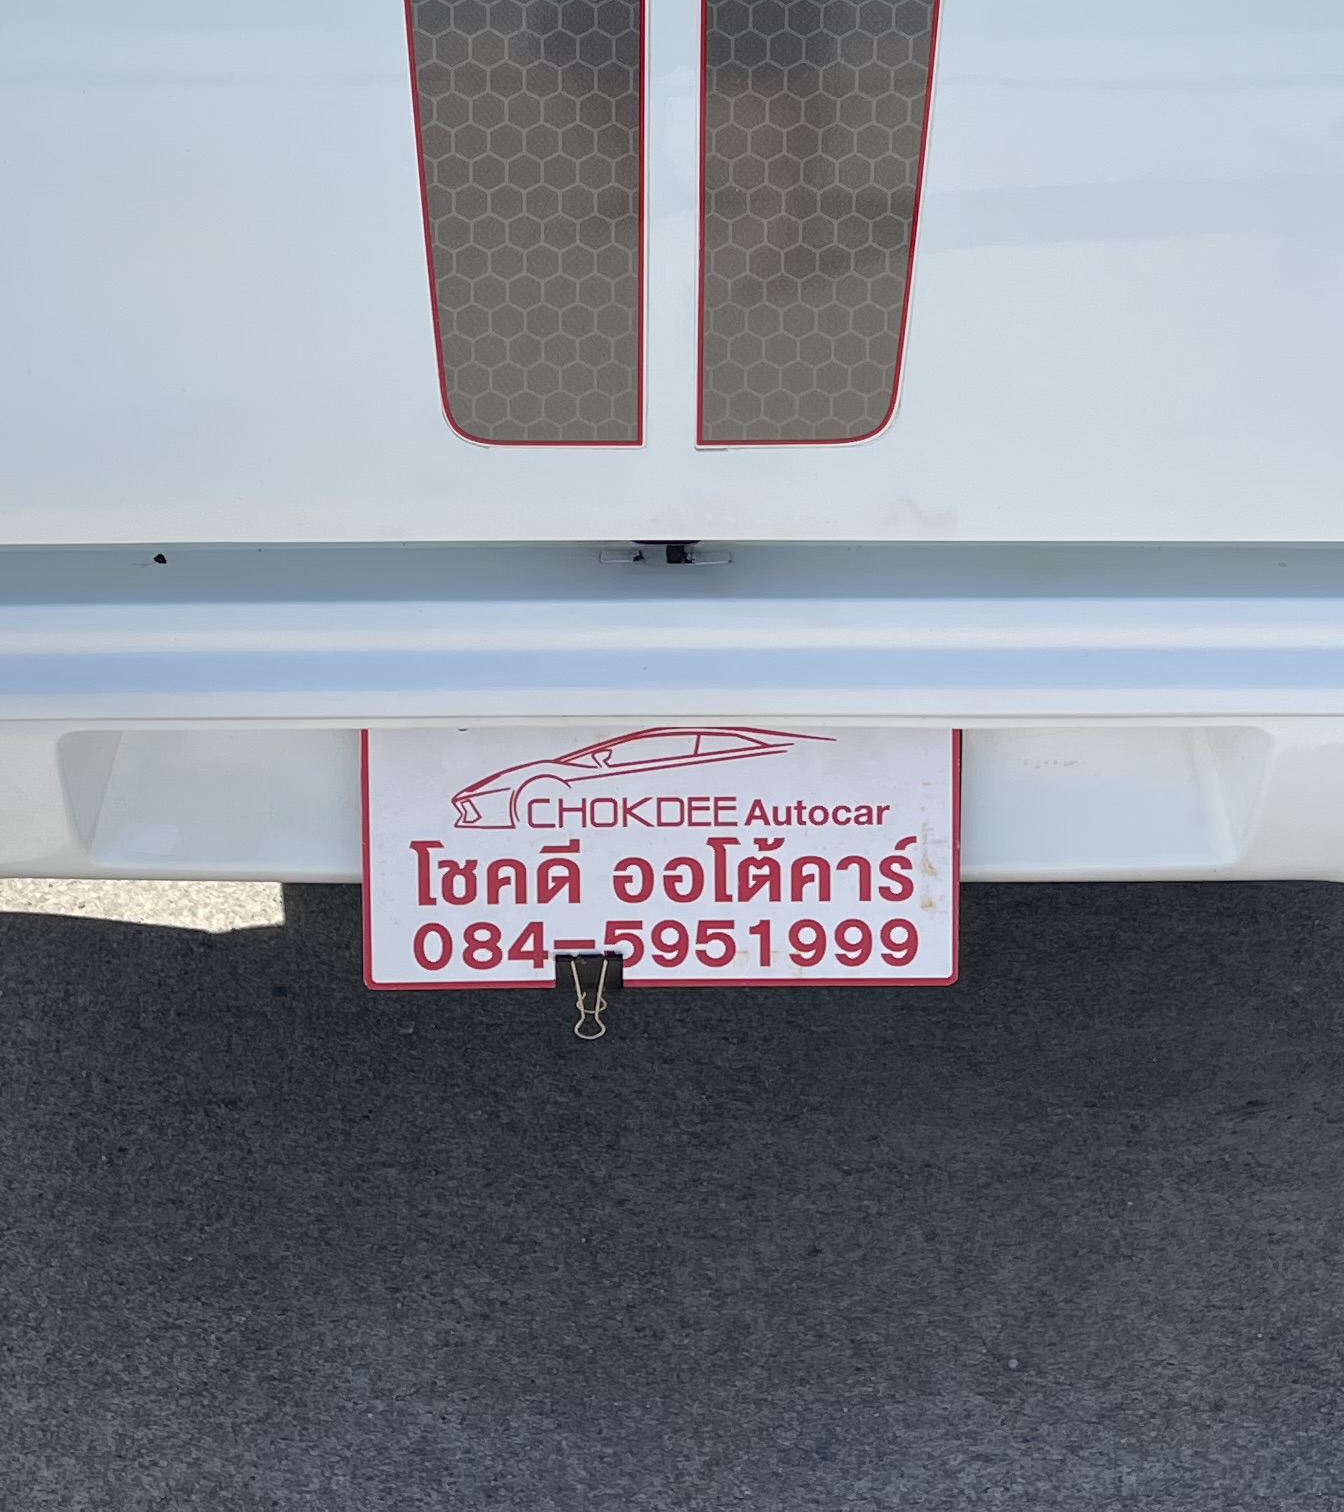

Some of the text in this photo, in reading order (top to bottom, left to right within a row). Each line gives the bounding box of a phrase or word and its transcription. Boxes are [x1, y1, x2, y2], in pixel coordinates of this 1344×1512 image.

[526, 796, 891, 829] CHOKDEE Autocar
[409, 835, 918, 906] โชคดี ออโต้คาร์
[412, 917, 920, 971] 084-5951999
